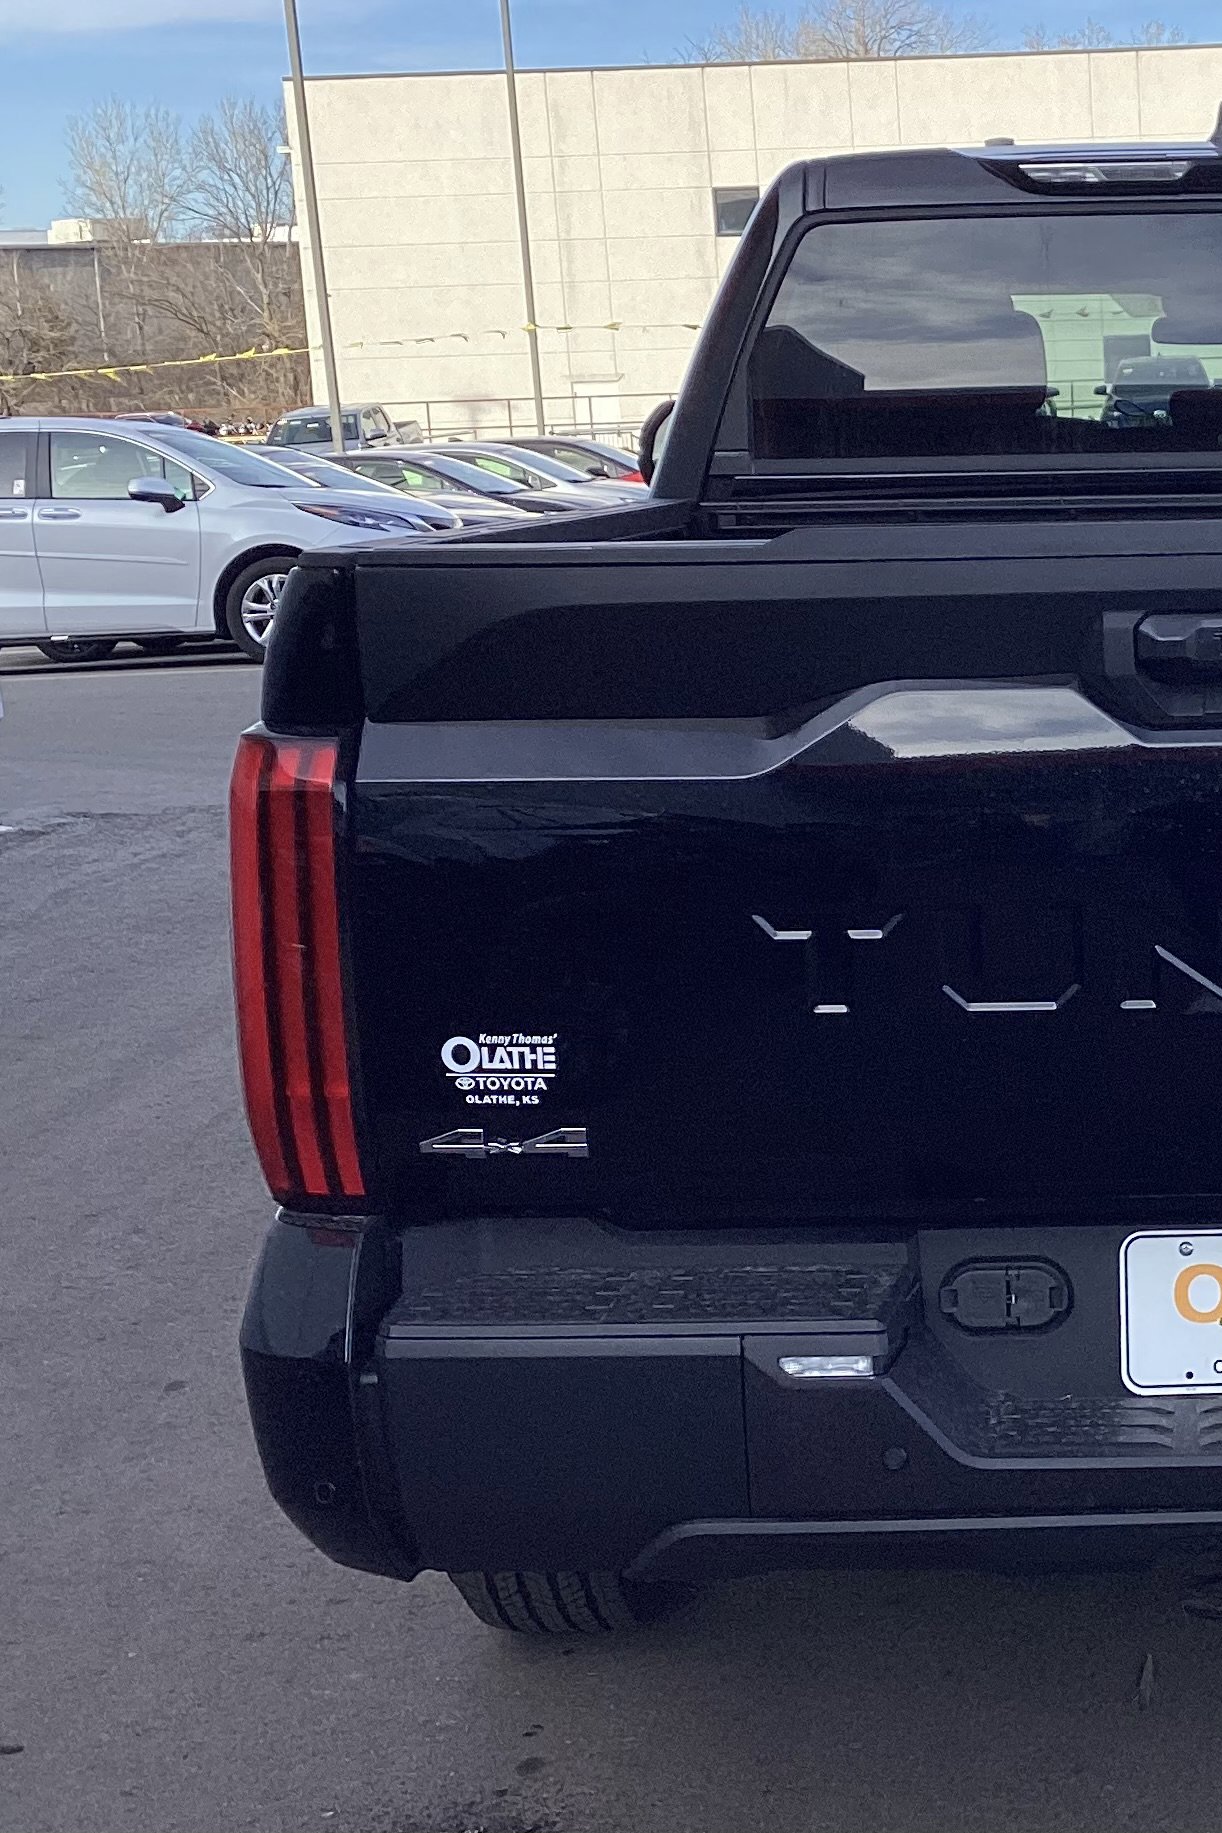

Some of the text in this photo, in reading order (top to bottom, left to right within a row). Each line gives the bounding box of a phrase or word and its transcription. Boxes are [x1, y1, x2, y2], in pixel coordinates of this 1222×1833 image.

[478, 1033, 511, 1045] Kenny
[441, 1036, 557, 1073] OLATHE
[475, 1077, 548, 1091] TOYOTA
[465, 1095, 539, 1106] OLATHE, KS
